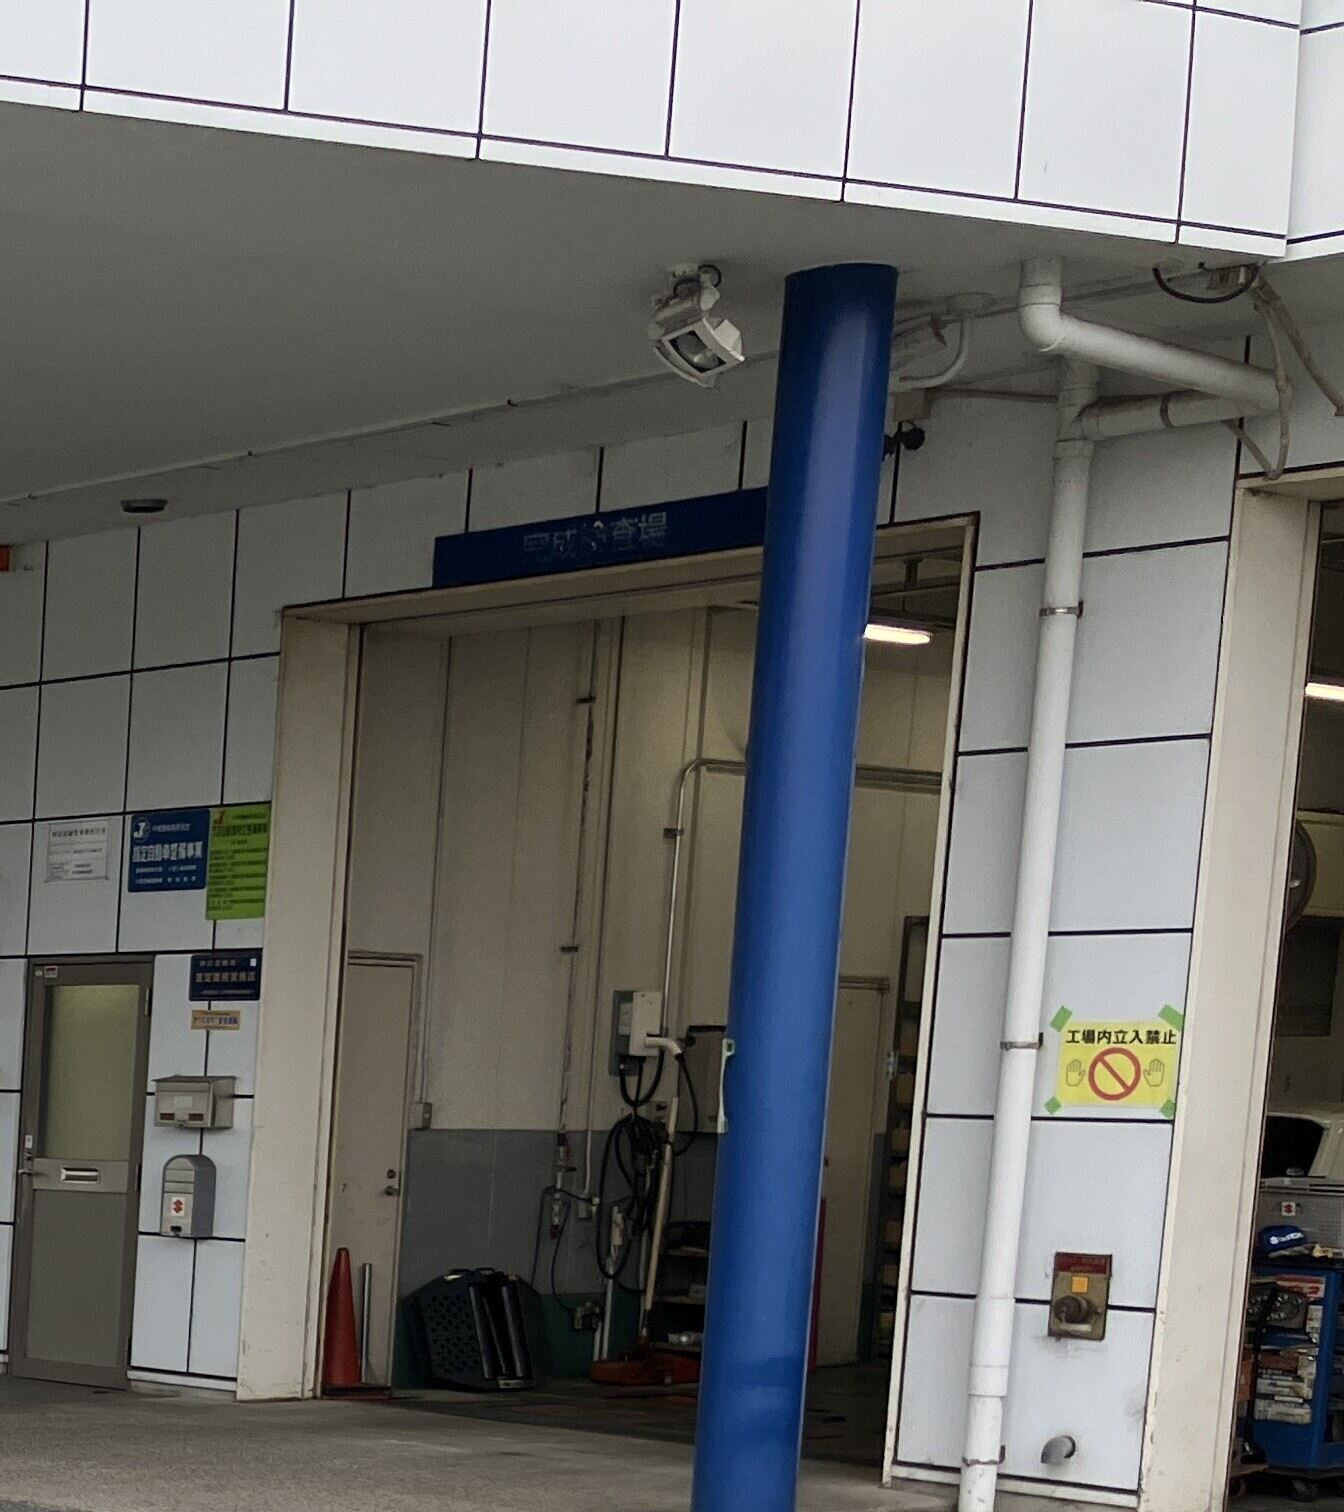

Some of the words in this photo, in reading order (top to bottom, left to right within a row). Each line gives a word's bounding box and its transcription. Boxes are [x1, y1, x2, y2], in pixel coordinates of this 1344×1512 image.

[1066, 1029, 1176, 1044] 工場内立入禁止
